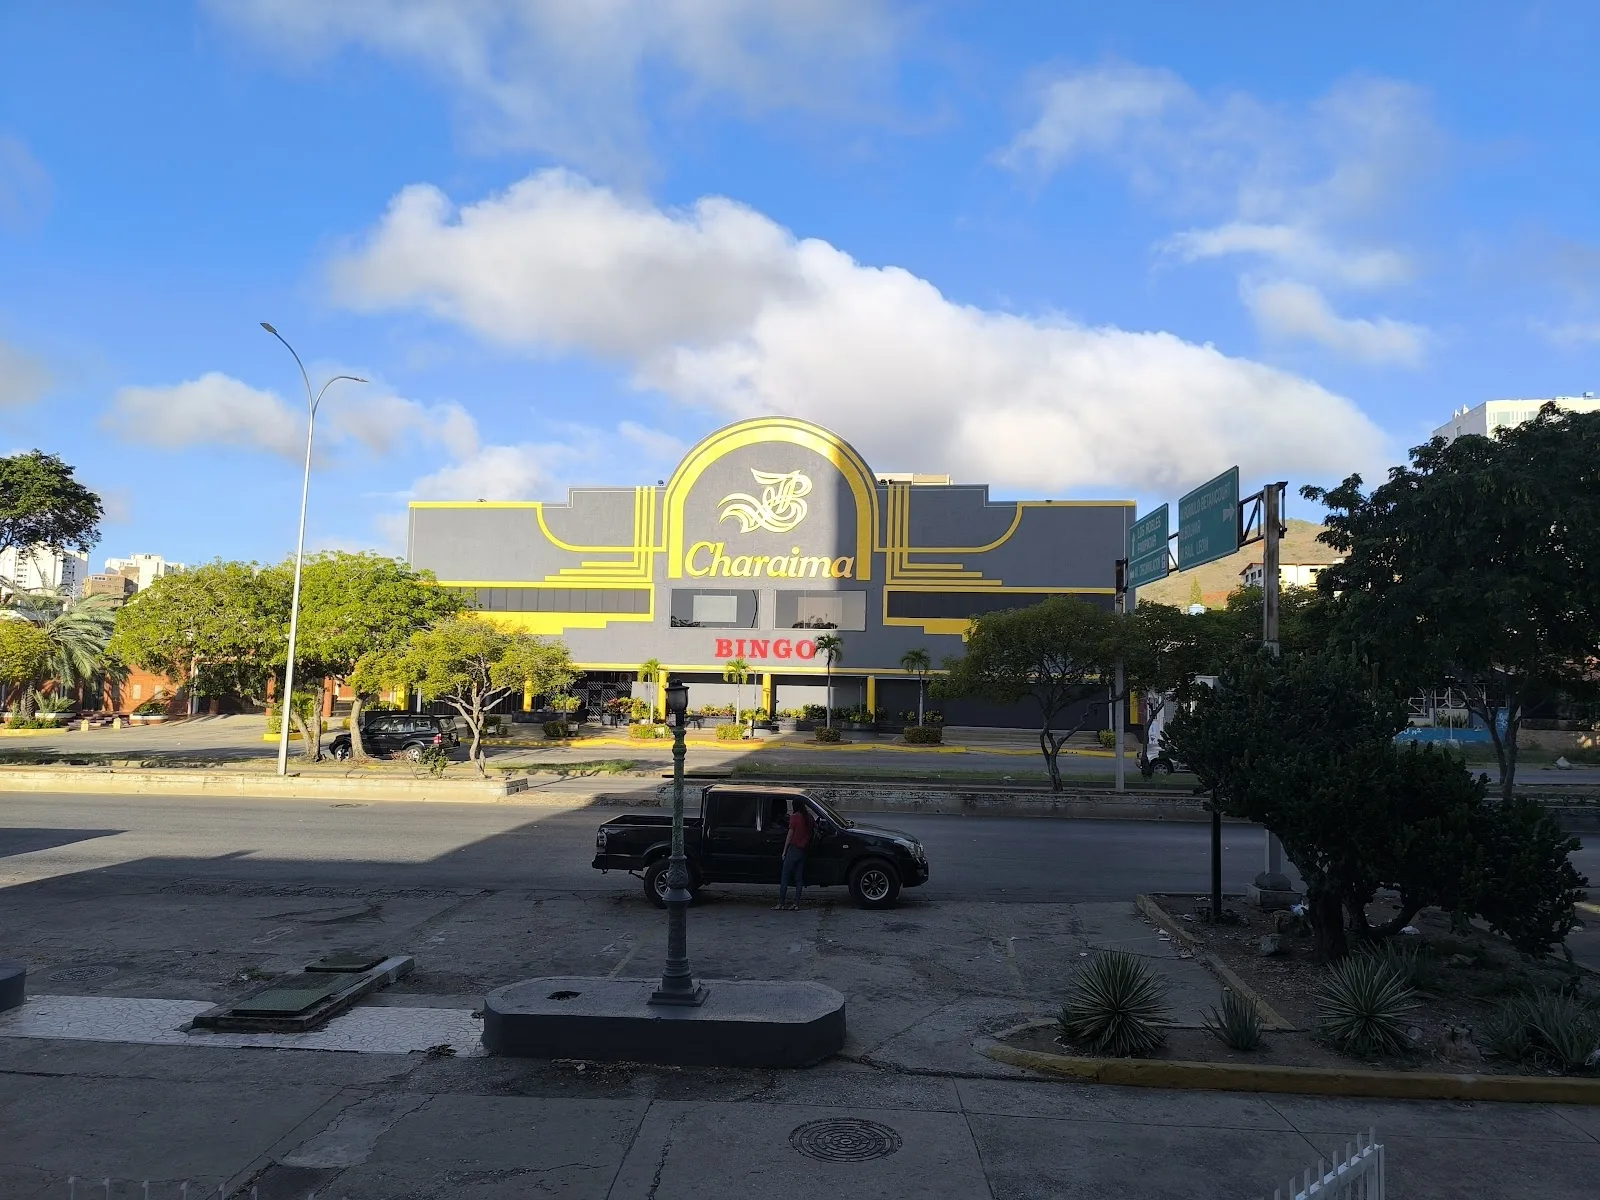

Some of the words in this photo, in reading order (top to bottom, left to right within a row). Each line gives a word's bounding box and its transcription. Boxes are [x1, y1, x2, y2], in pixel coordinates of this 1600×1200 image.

[1145, 515, 1162, 534] ROBLES
[684, 541, 855, 579] Charaima
[714, 638, 817, 660] BINGO
